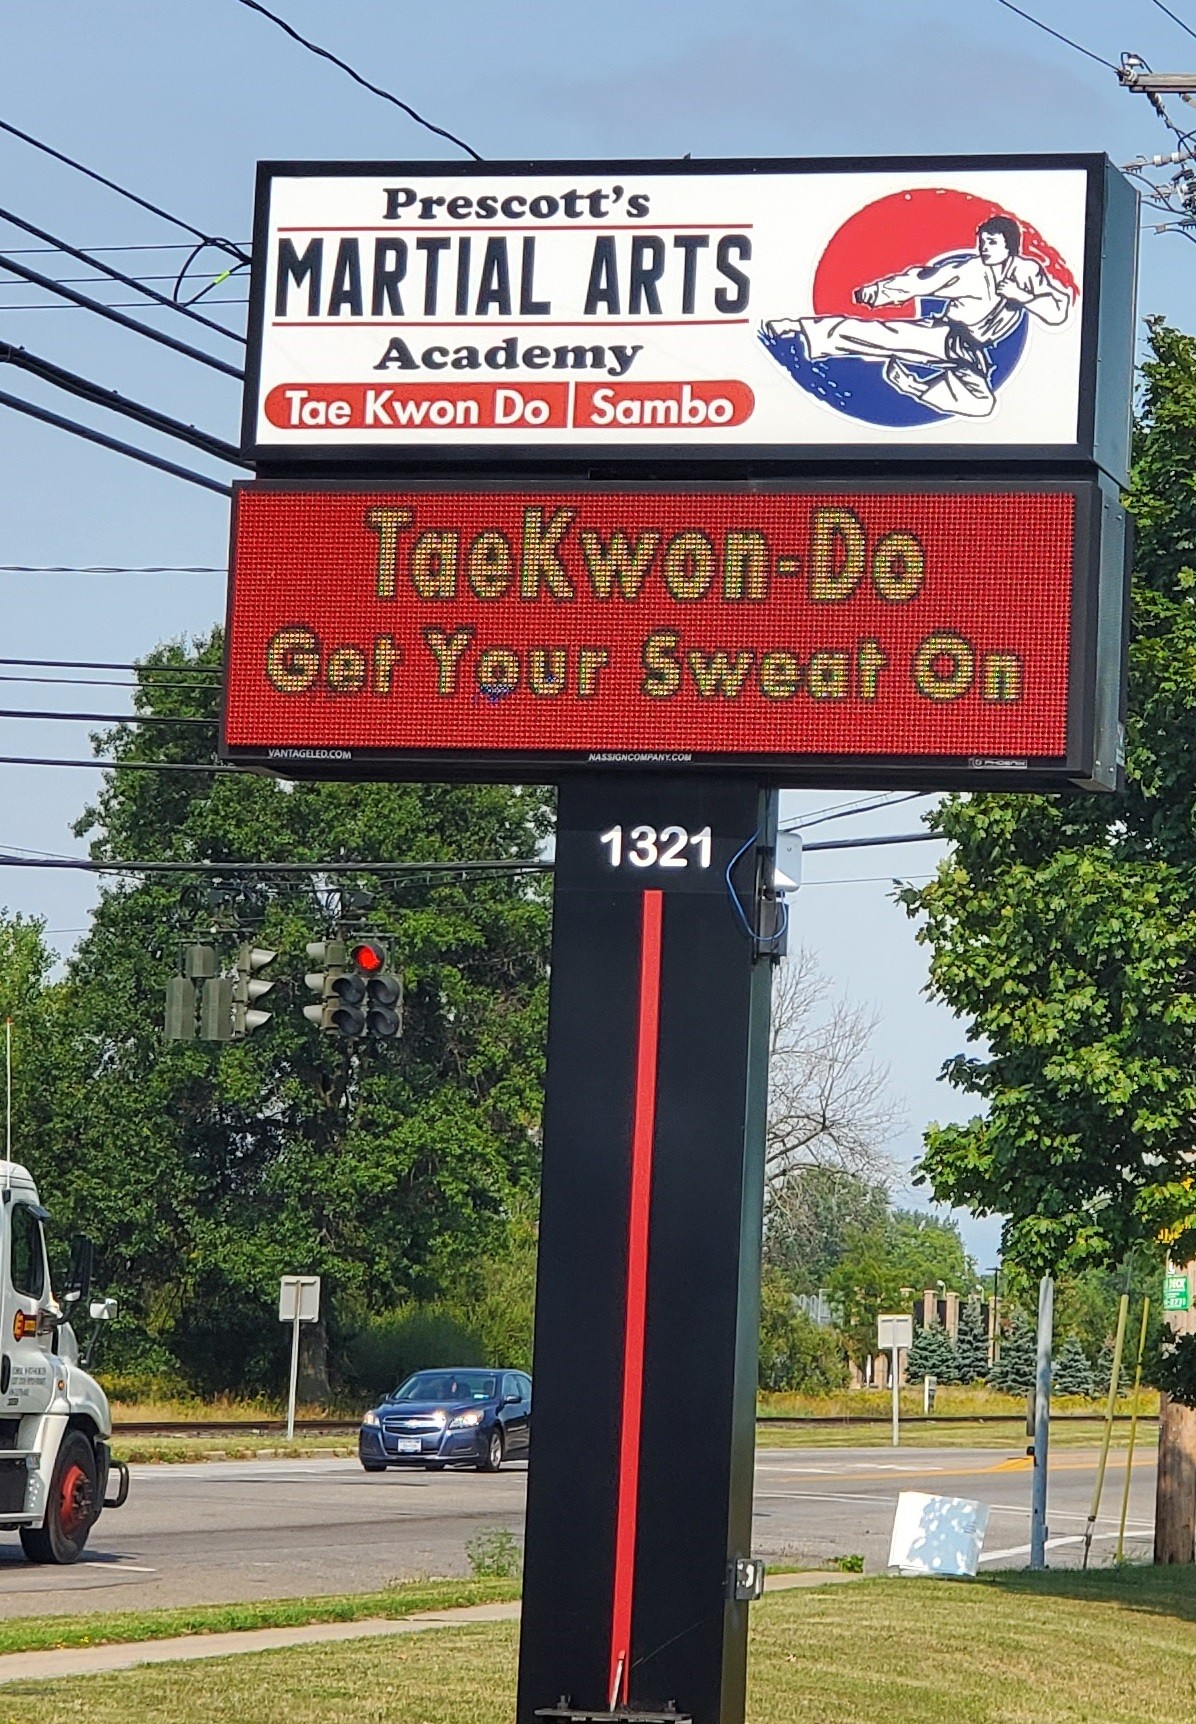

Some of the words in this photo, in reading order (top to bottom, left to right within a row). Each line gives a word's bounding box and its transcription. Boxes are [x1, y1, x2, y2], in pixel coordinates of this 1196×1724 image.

[383, 186, 650, 220] Prescott's
[274, 236, 551, 316] MARTIAL
[584, 233, 751, 315] ARTS
[373, 337, 643, 376] Academy
[285, 390, 352, 427] Tae
[364, 390, 480, 427] Kwon
[495, 389, 551, 427] Do
[590, 384, 736, 426] Sambo
[366, 505, 926, 603] TaeKwon-Do
[267, 626, 394, 695] Get
[423, 625, 608, 698] Your
[641, 631, 887, 702] Sweat
[915, 631, 1024, 703] On
[267, 748, 352, 760] VANTAGELED.COM
[588, 753, 693, 762] NASSIGNCOMPANY.COM
[600, 824, 712, 869] 1321
